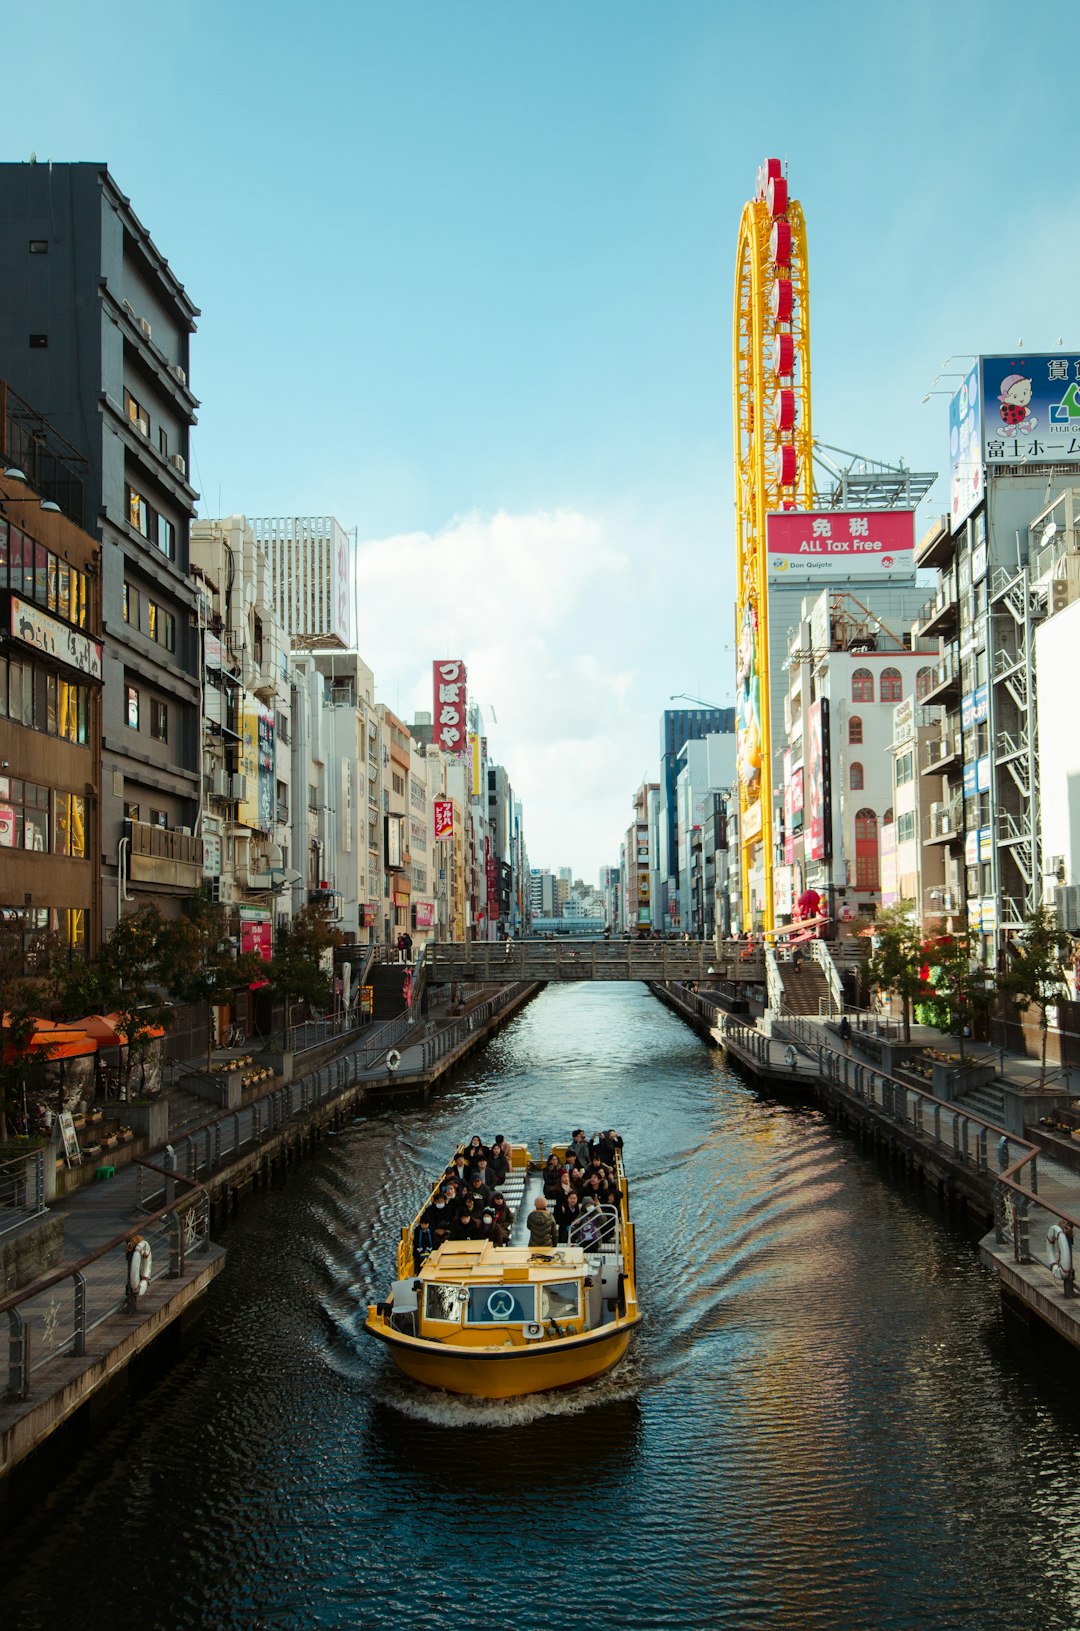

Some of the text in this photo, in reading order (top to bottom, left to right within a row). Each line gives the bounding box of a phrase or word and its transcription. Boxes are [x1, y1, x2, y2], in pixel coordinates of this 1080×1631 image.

[1048, 360, 1080, 381] 賃
[1050, 425, 1070, 434] FUJI
[987, 438, 1080, 458] 富士ホーム
[812, 518, 869, 537] 免税
[800, 540, 882, 552] ALL Tax Free
[806, 561, 832, 569] Quijote
[439, 661, 462, 747] づぼらや
[443, 803, 452, 825] ツルハ
